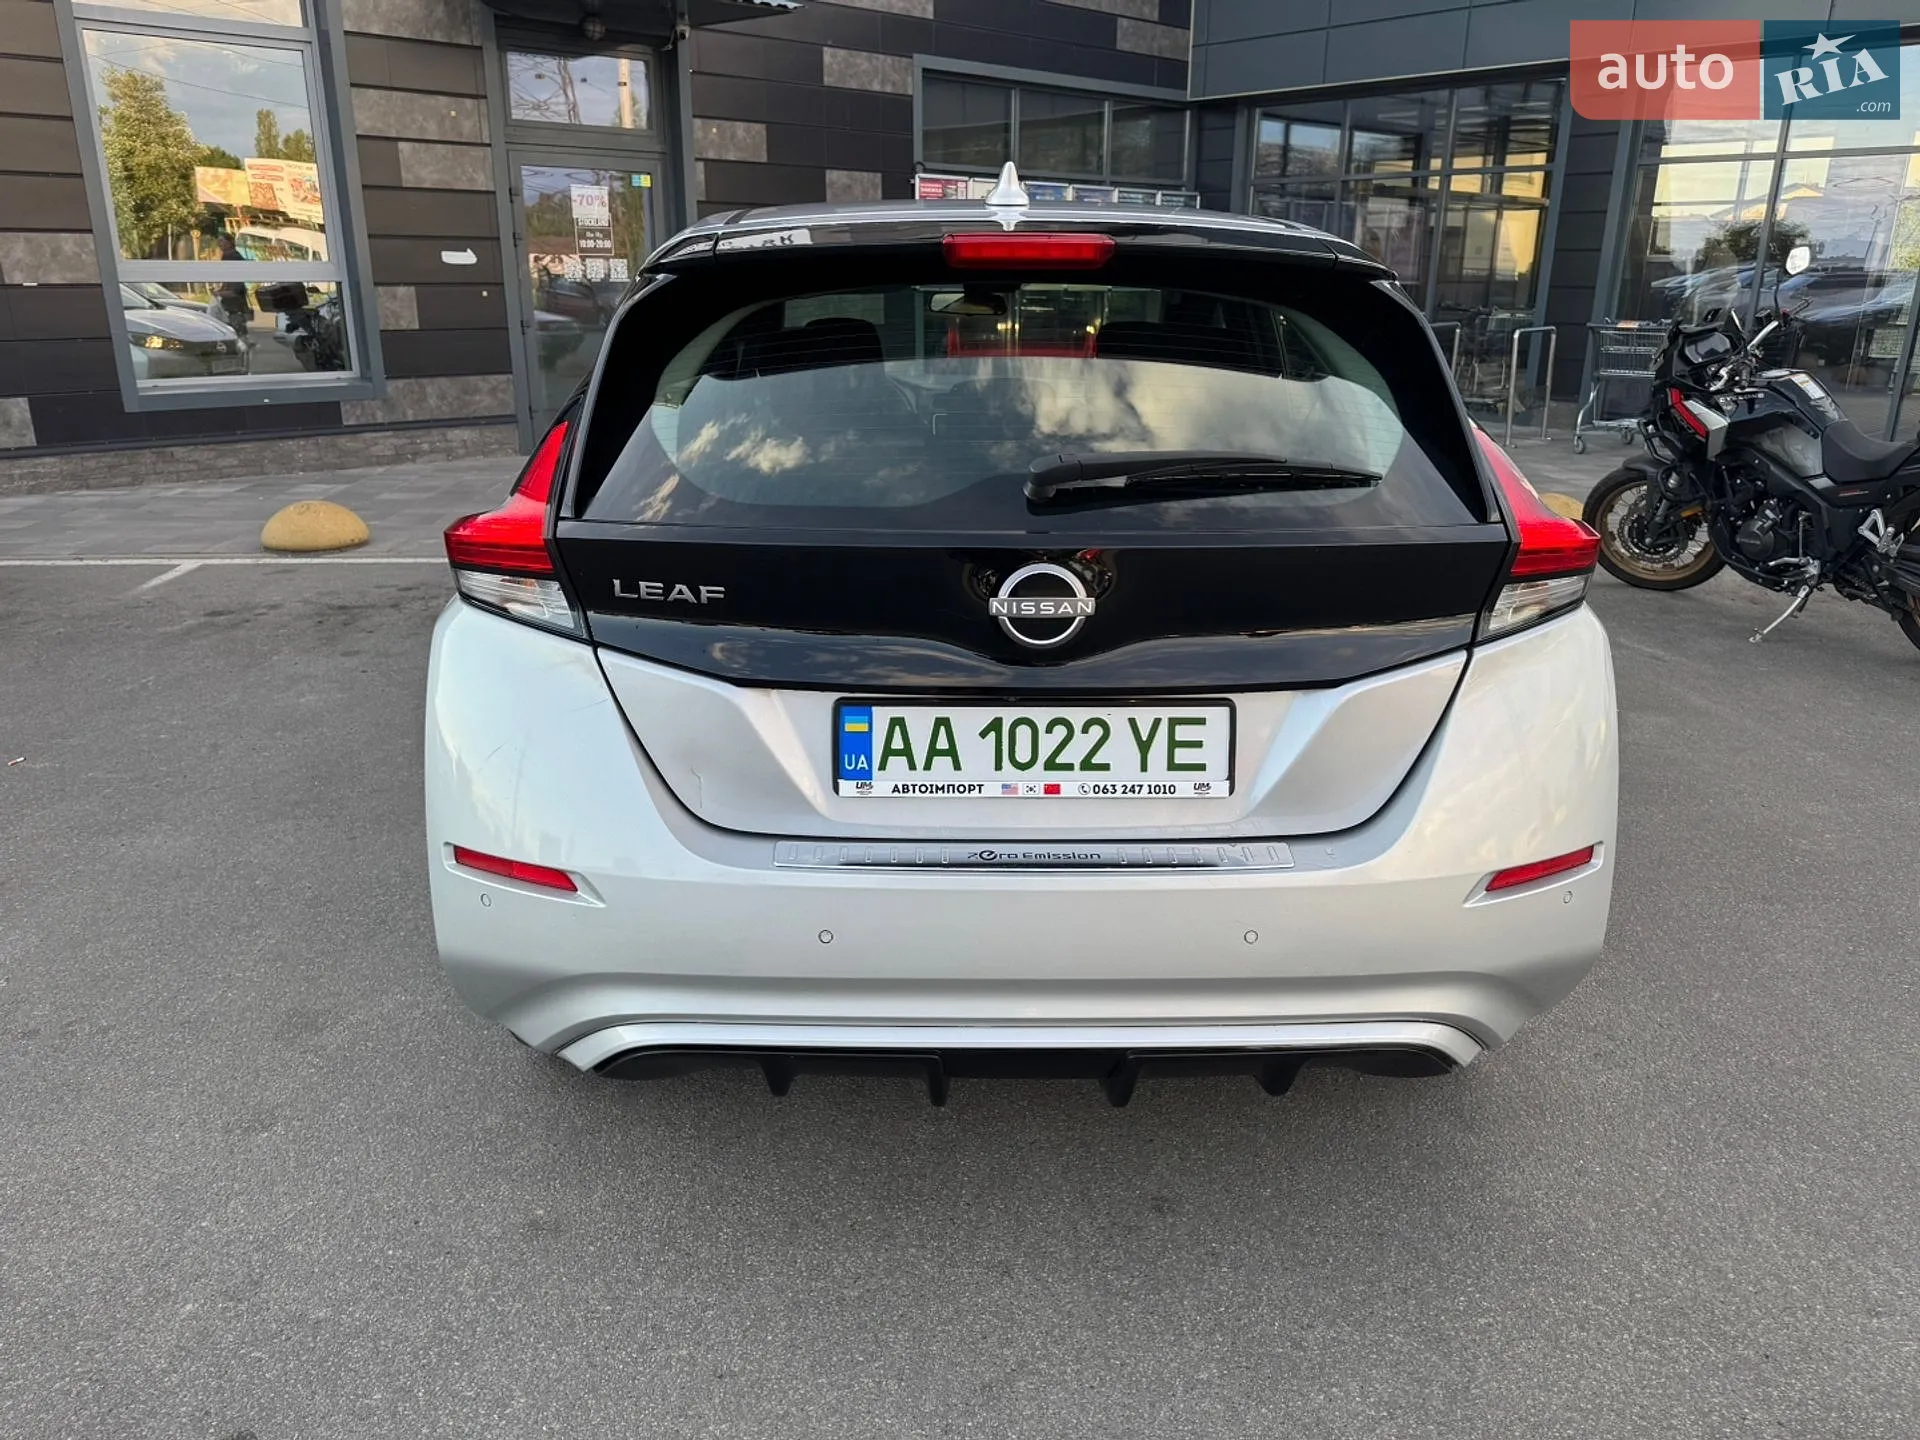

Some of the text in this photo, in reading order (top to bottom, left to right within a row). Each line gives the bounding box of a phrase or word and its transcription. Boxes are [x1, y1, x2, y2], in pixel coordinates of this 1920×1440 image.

[612, 579, 726, 604] LEAF
[991, 601, 1093, 615] NISSAN
[877, 716, 1207, 772] AA 1022 YE
[844, 753, 869, 771] UA
[891, 783, 985, 795] АВТОІМПОРТ
[1092, 783, 1176, 795] 063 247 1010
